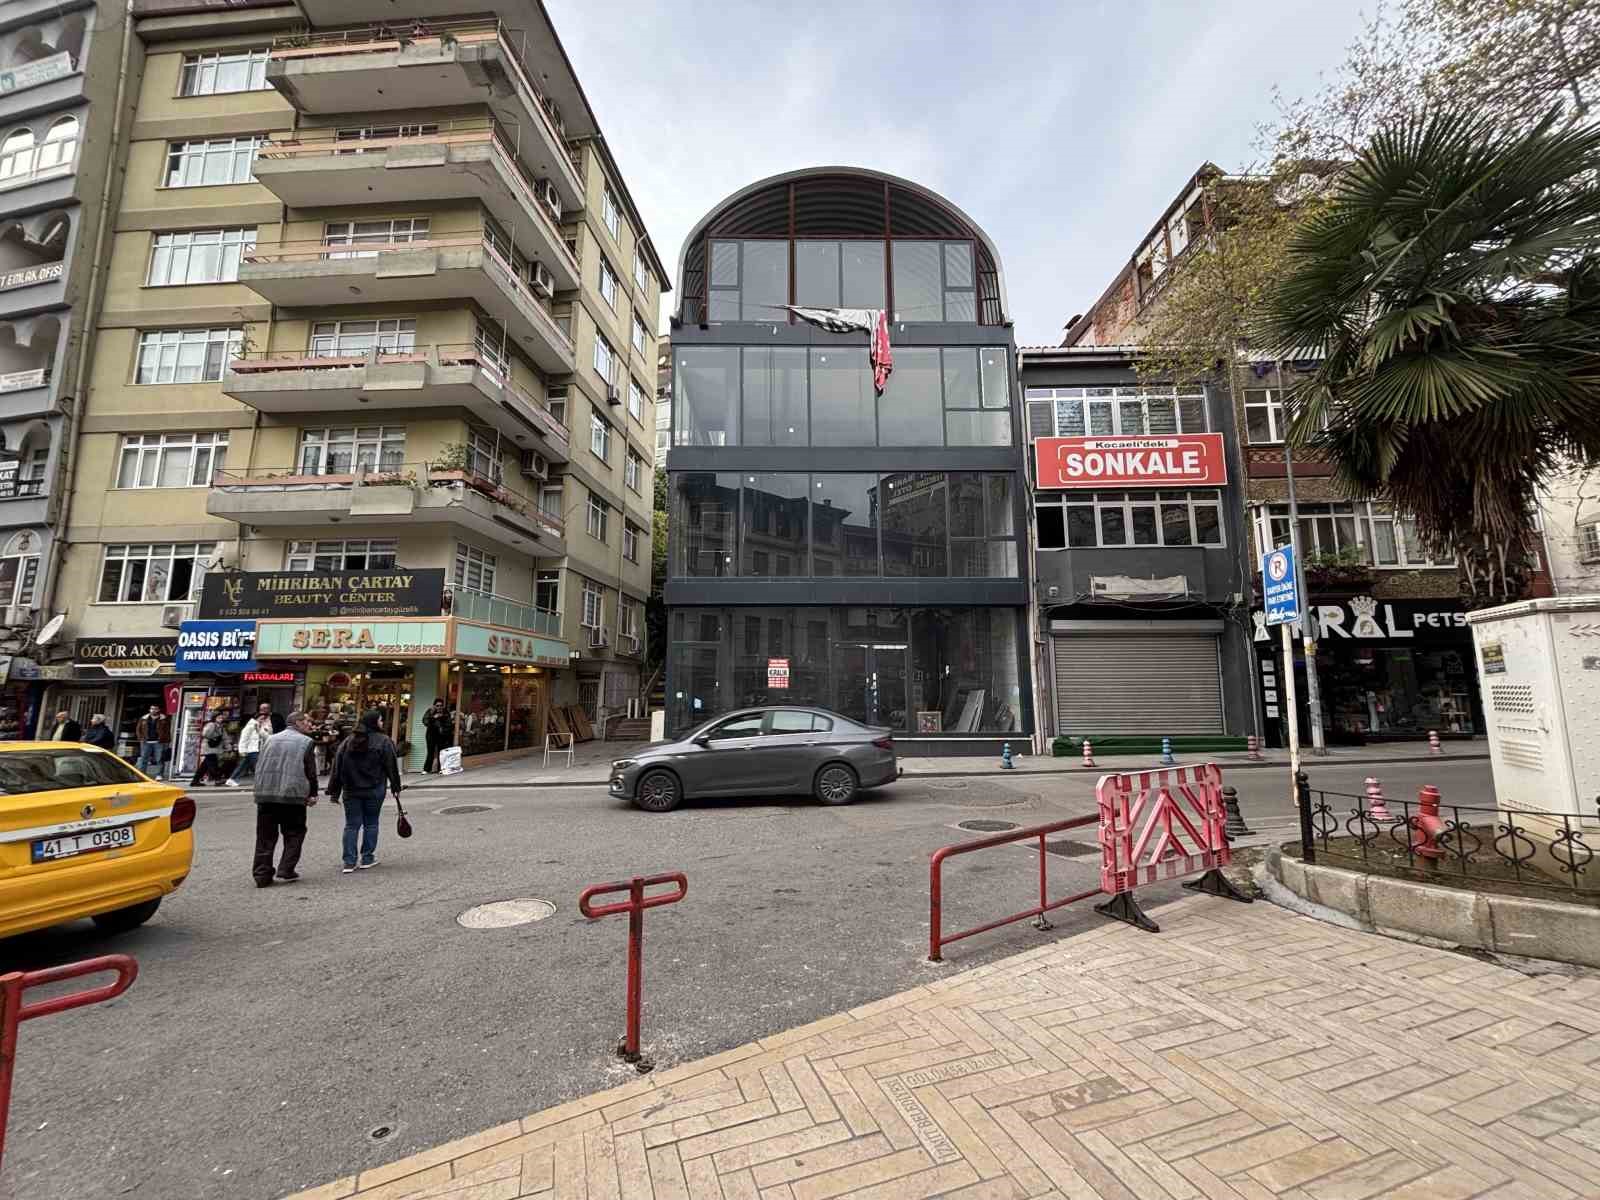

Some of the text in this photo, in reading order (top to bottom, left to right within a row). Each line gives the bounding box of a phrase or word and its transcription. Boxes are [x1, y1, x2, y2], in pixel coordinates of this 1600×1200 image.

[8, 271, 37, 285] EMLAK
[1066, 451, 1201, 477] SONKALE
[257, 574, 413, 592] MİHRİBAN ÇARTAY
[274, 592, 396, 605] BEAUTY CENTER
[1413, 612, 1471, 628] PETS
[178, 632, 219, 648] OASIS
[293, 628, 375, 649] SERA
[488, 634, 533, 658] SERA
[130, 644, 177, 657] AKKAY
[184, 649, 248, 660] FATURA VİZYON
[45, 829, 130, 853] 41 T 0308
